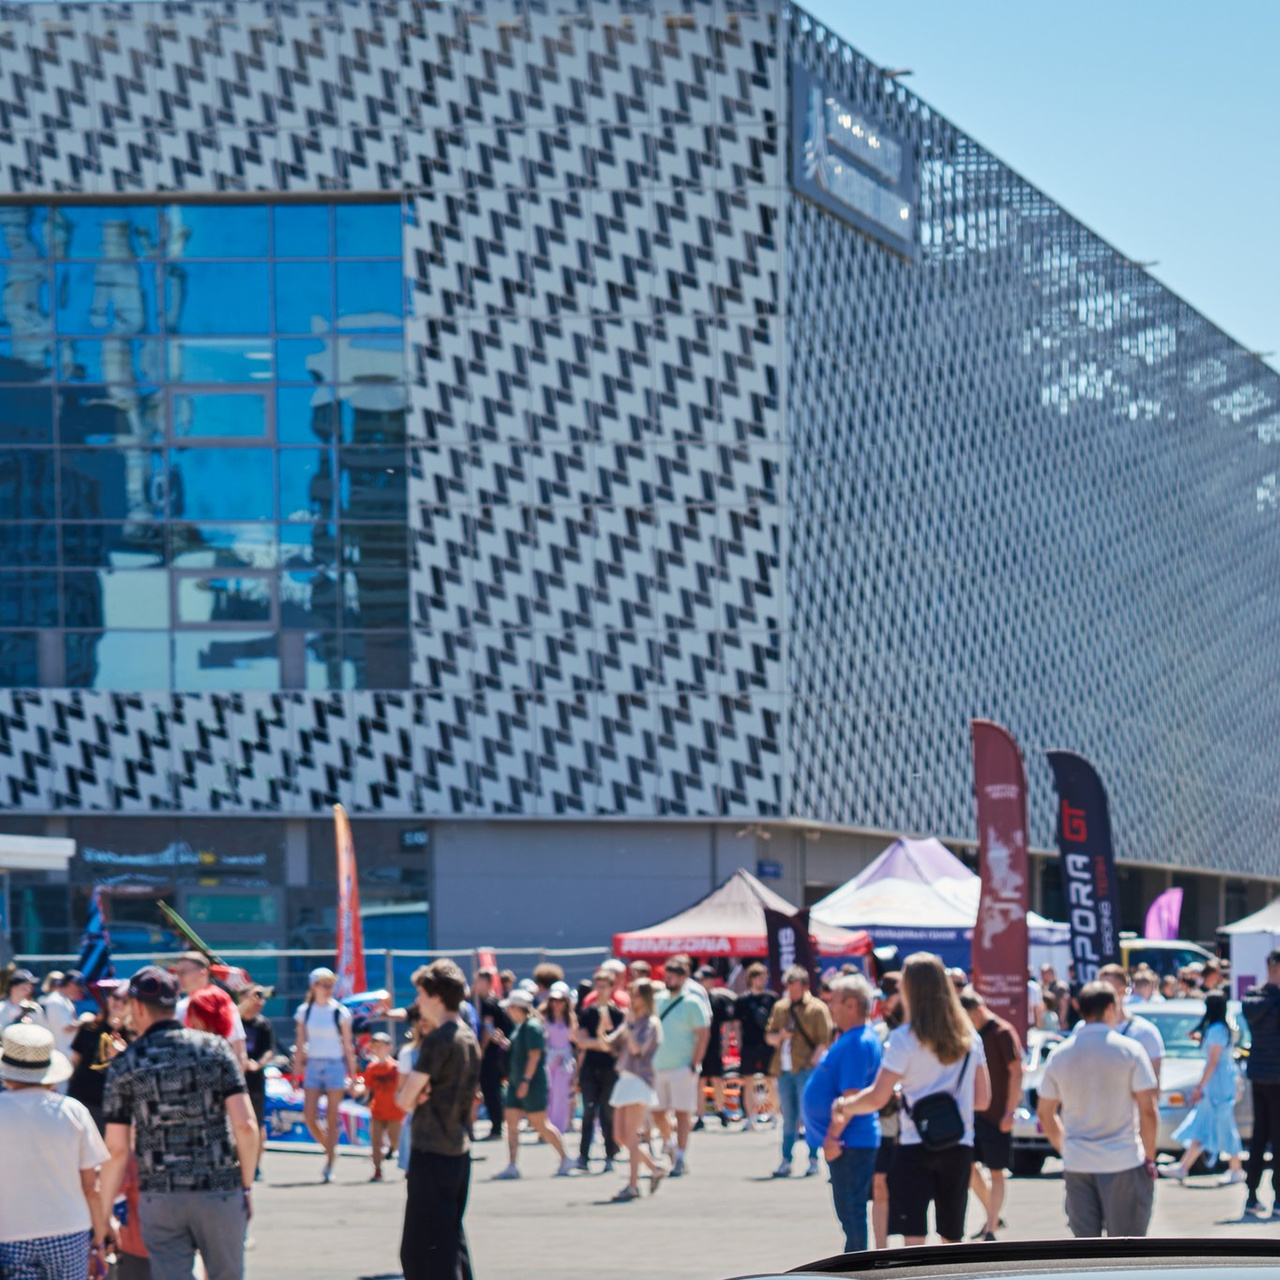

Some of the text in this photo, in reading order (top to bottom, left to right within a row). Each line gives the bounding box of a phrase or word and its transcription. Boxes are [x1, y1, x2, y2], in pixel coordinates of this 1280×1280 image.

[1062, 799, 1100, 985] SPORA GT
[1094, 854, 1115, 956] RACING TEAM
